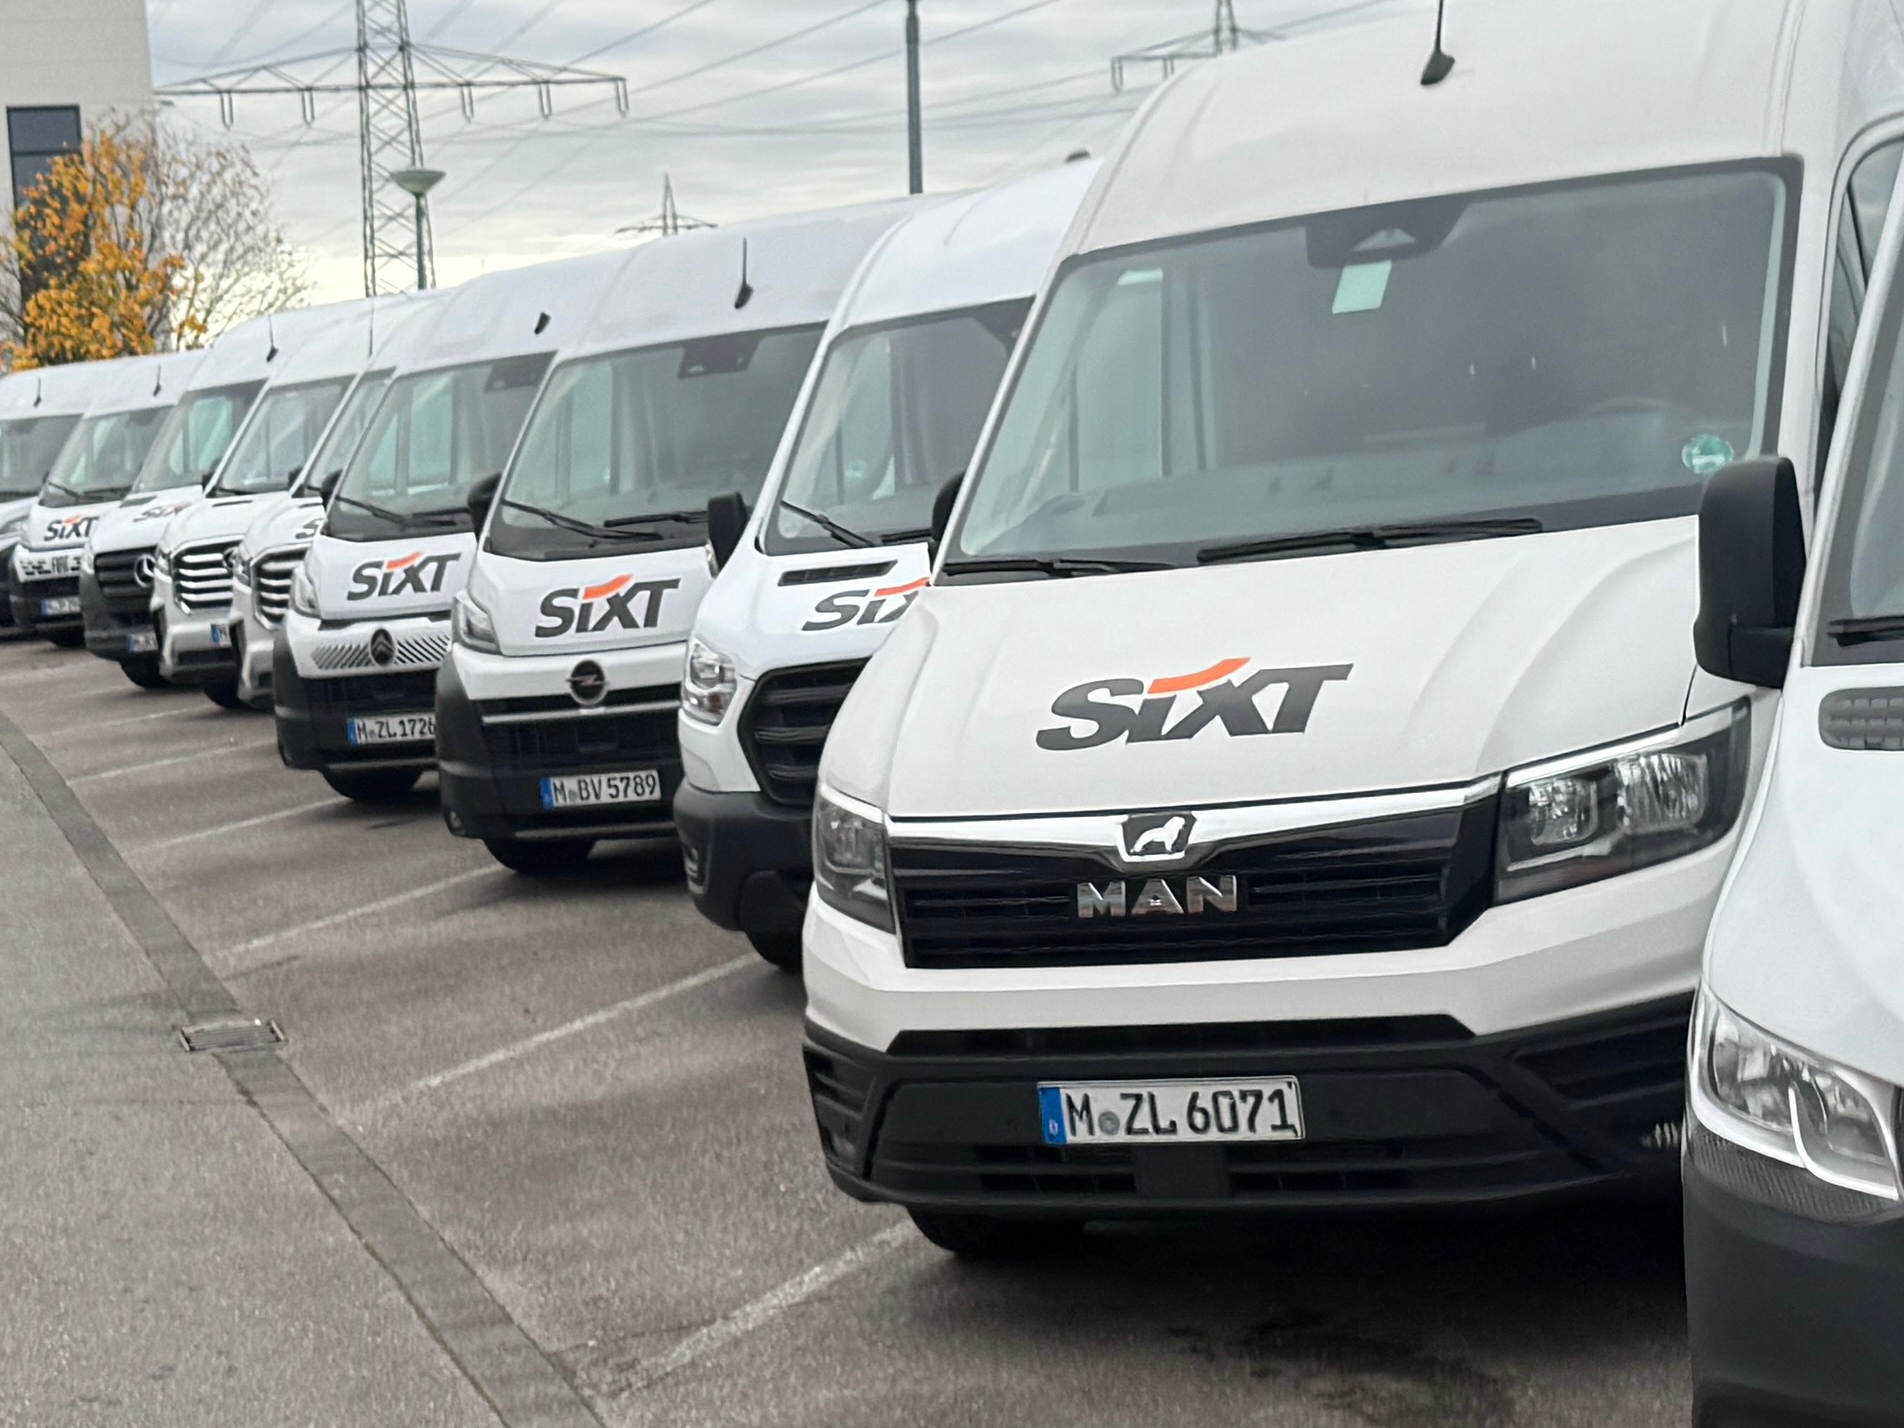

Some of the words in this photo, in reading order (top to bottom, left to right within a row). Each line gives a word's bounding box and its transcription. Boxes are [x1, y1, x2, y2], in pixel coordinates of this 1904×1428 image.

[44, 515, 100, 541] SIXT
[347, 551, 461, 601] SIXT
[535, 574, 680, 637] SIXT
[1036, 657, 1354, 751] SIXT
[577, 776, 602, 801] BV
[607, 773, 656, 799] 5789
[1077, 874, 1238, 919] MAN
[1065, 1093, 1095, 1137] M
[1120, 1091, 1178, 1135] ZL
[1186, 1088, 1296, 1135] 6071
